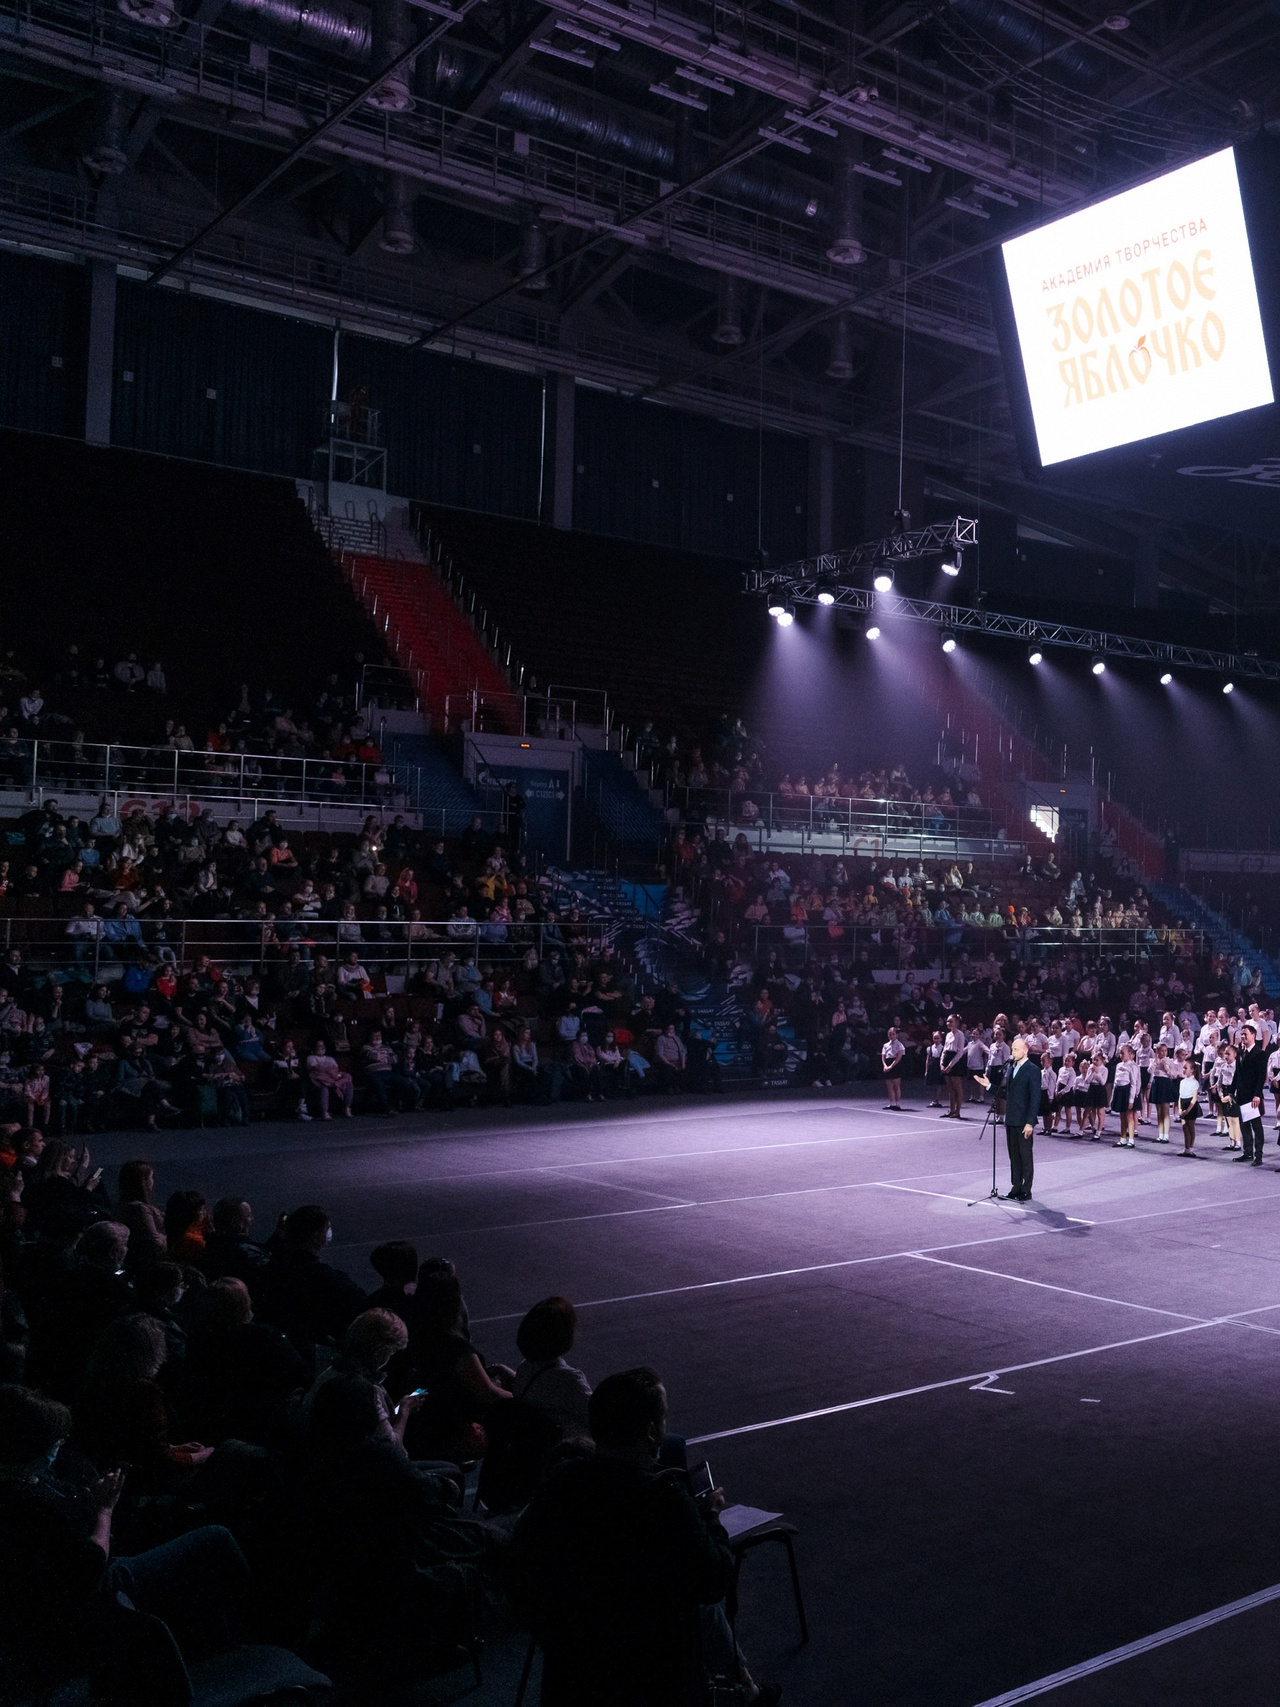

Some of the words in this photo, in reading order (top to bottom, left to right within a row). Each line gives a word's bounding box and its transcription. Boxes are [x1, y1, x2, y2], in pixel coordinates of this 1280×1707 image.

[1041, 254, 1111, 294] АКАДЕМИЯ
[1114, 217, 1208, 265] ТВОРЧЕСТВА
[1057, 310, 1227, 409] ЯБЛОЧКО
